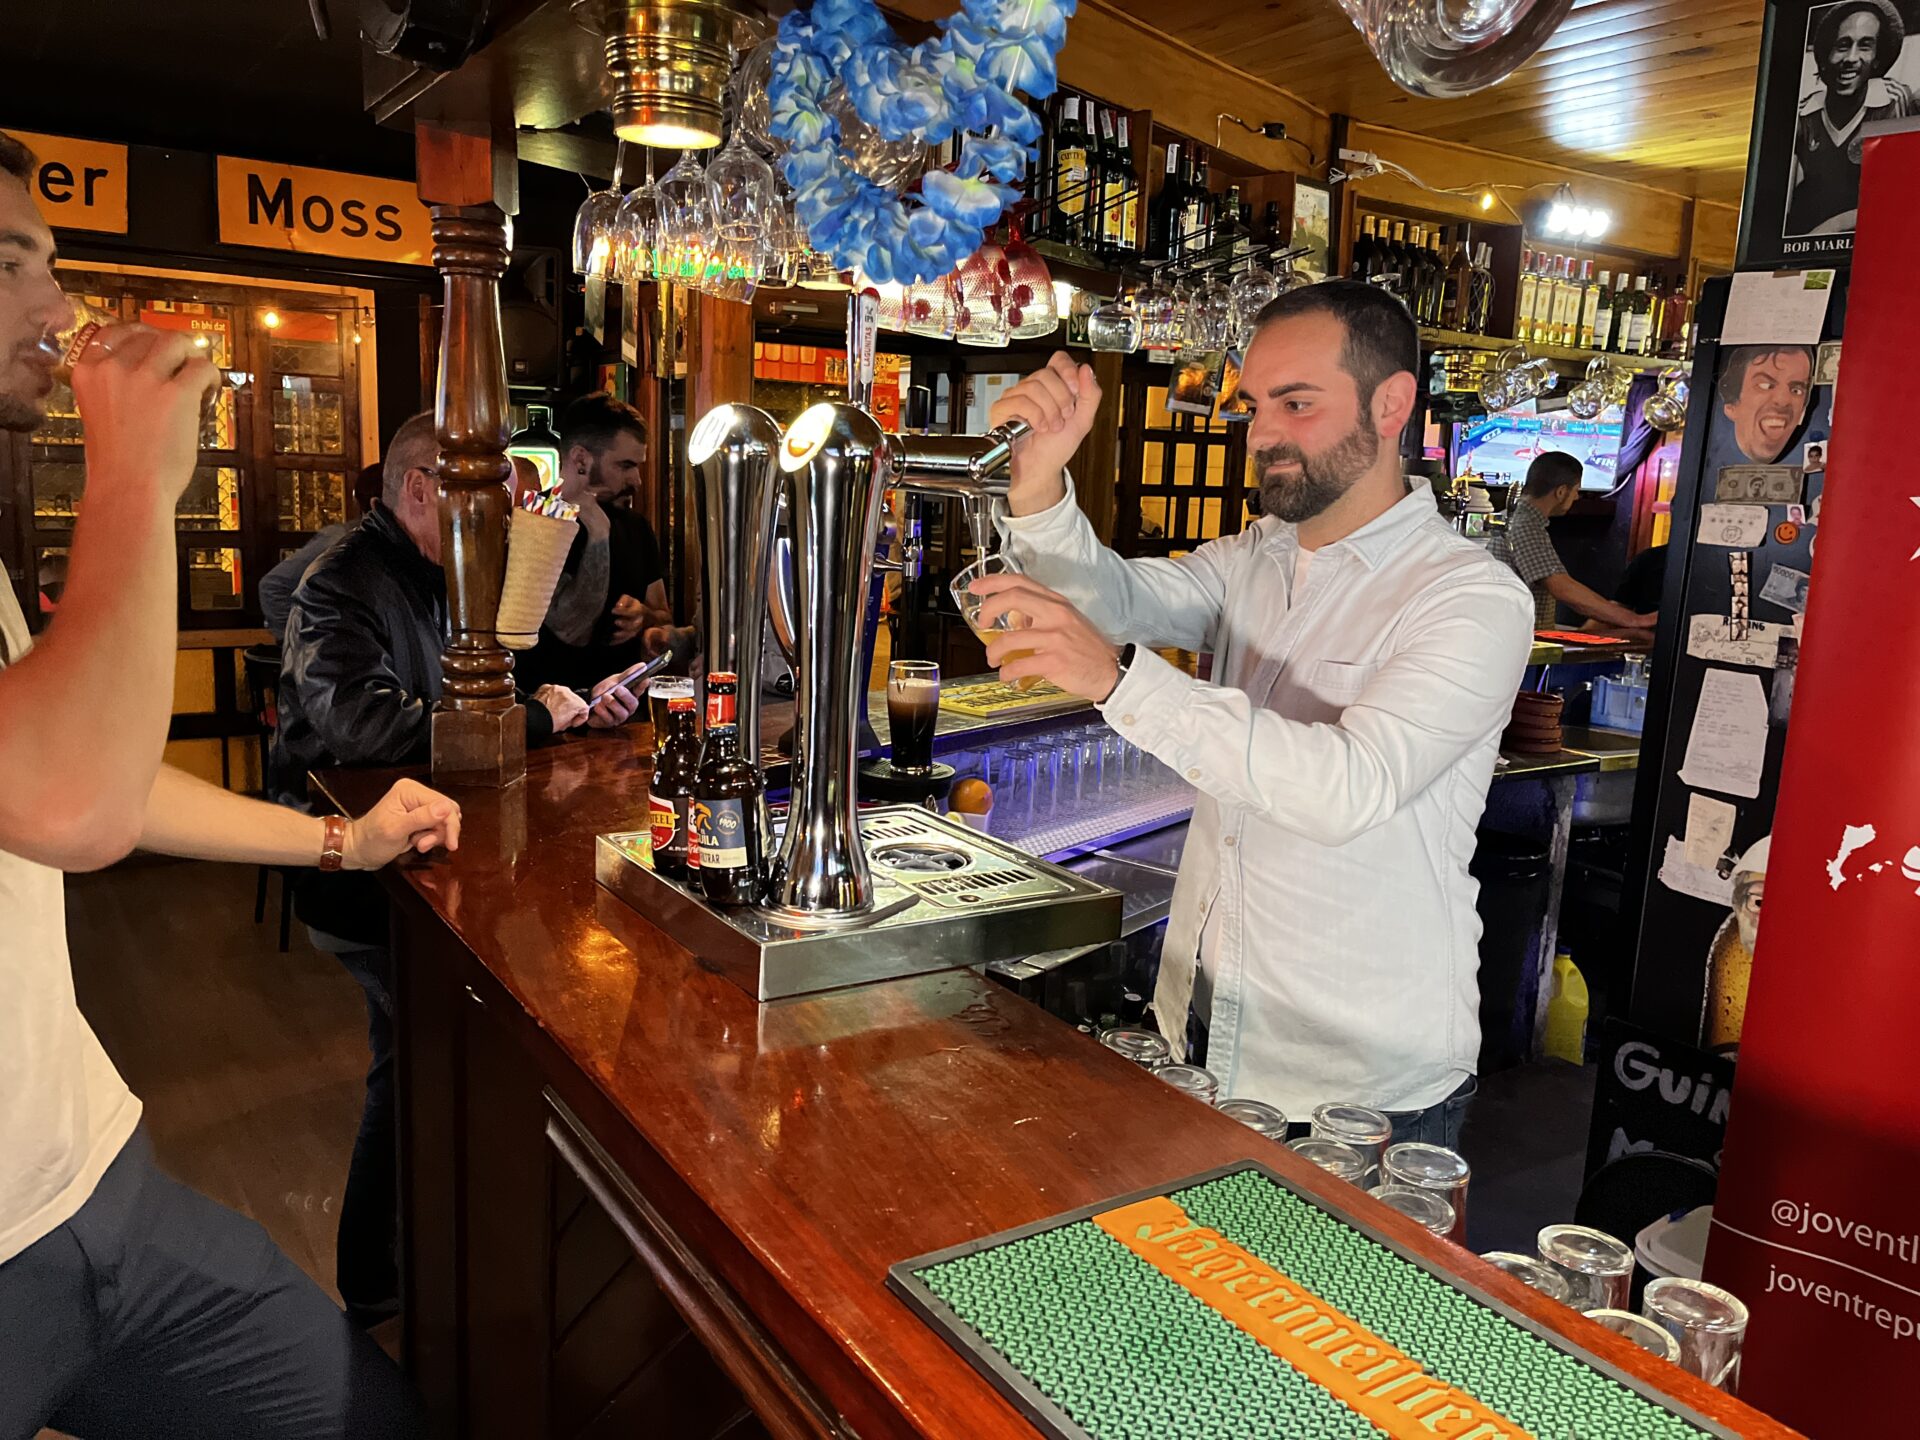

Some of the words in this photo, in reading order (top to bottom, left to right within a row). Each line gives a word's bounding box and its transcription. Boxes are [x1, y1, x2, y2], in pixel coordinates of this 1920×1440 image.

[247, 173, 403, 242] Moss
[1783, 241, 1810, 254] BOB
[1813, 238, 1854, 252] MARL
[863, 327, 873, 367] LAGUNITAS
[1764, 1263, 1920, 1342] joventrep
